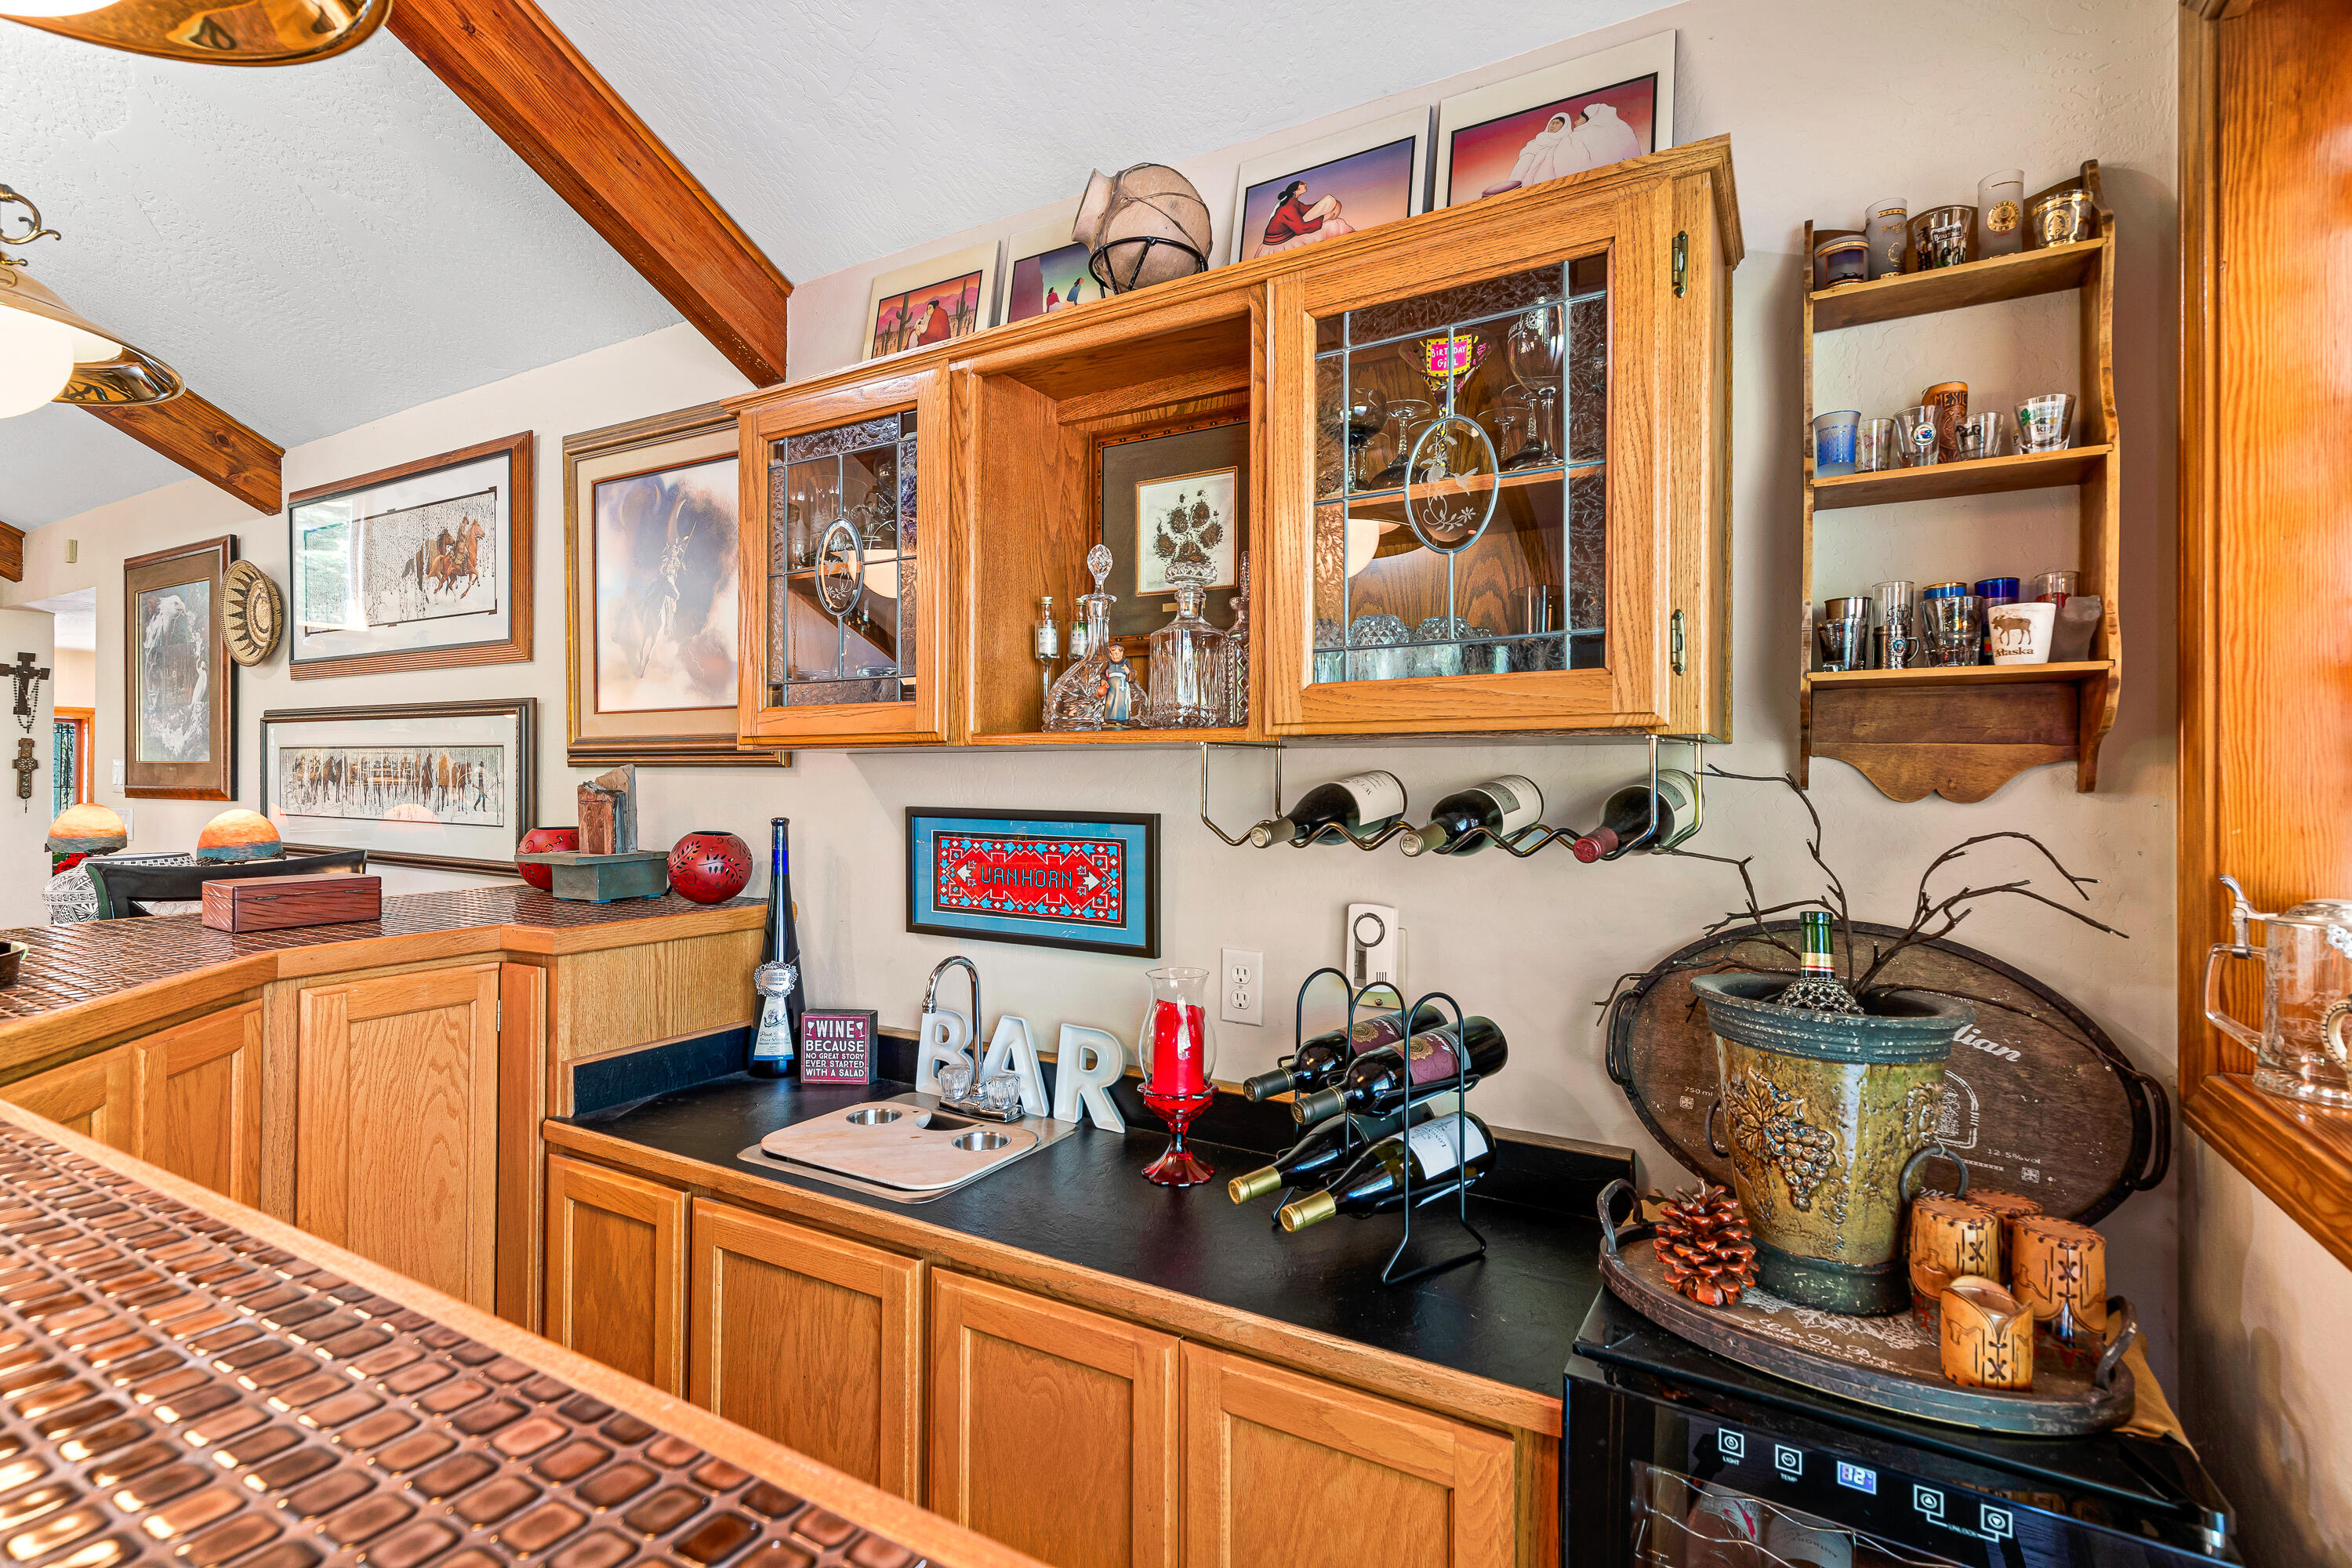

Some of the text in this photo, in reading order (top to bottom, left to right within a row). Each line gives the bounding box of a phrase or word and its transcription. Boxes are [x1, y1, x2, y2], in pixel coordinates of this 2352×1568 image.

[1431, 345, 1467, 358] BiRTDAY
[1437, 358, 1459, 368] GiL
[815, 1020, 855, 1038] WINE
[805, 1040, 865, 1052] BECAUSE
[915, 1007, 1127, 1134] BAR
[1683, 1086, 1700, 1094] 750
[1722, 1455, 1740, 1466] LIGHT
[1780, 1472, 1798, 1483] TEMP
